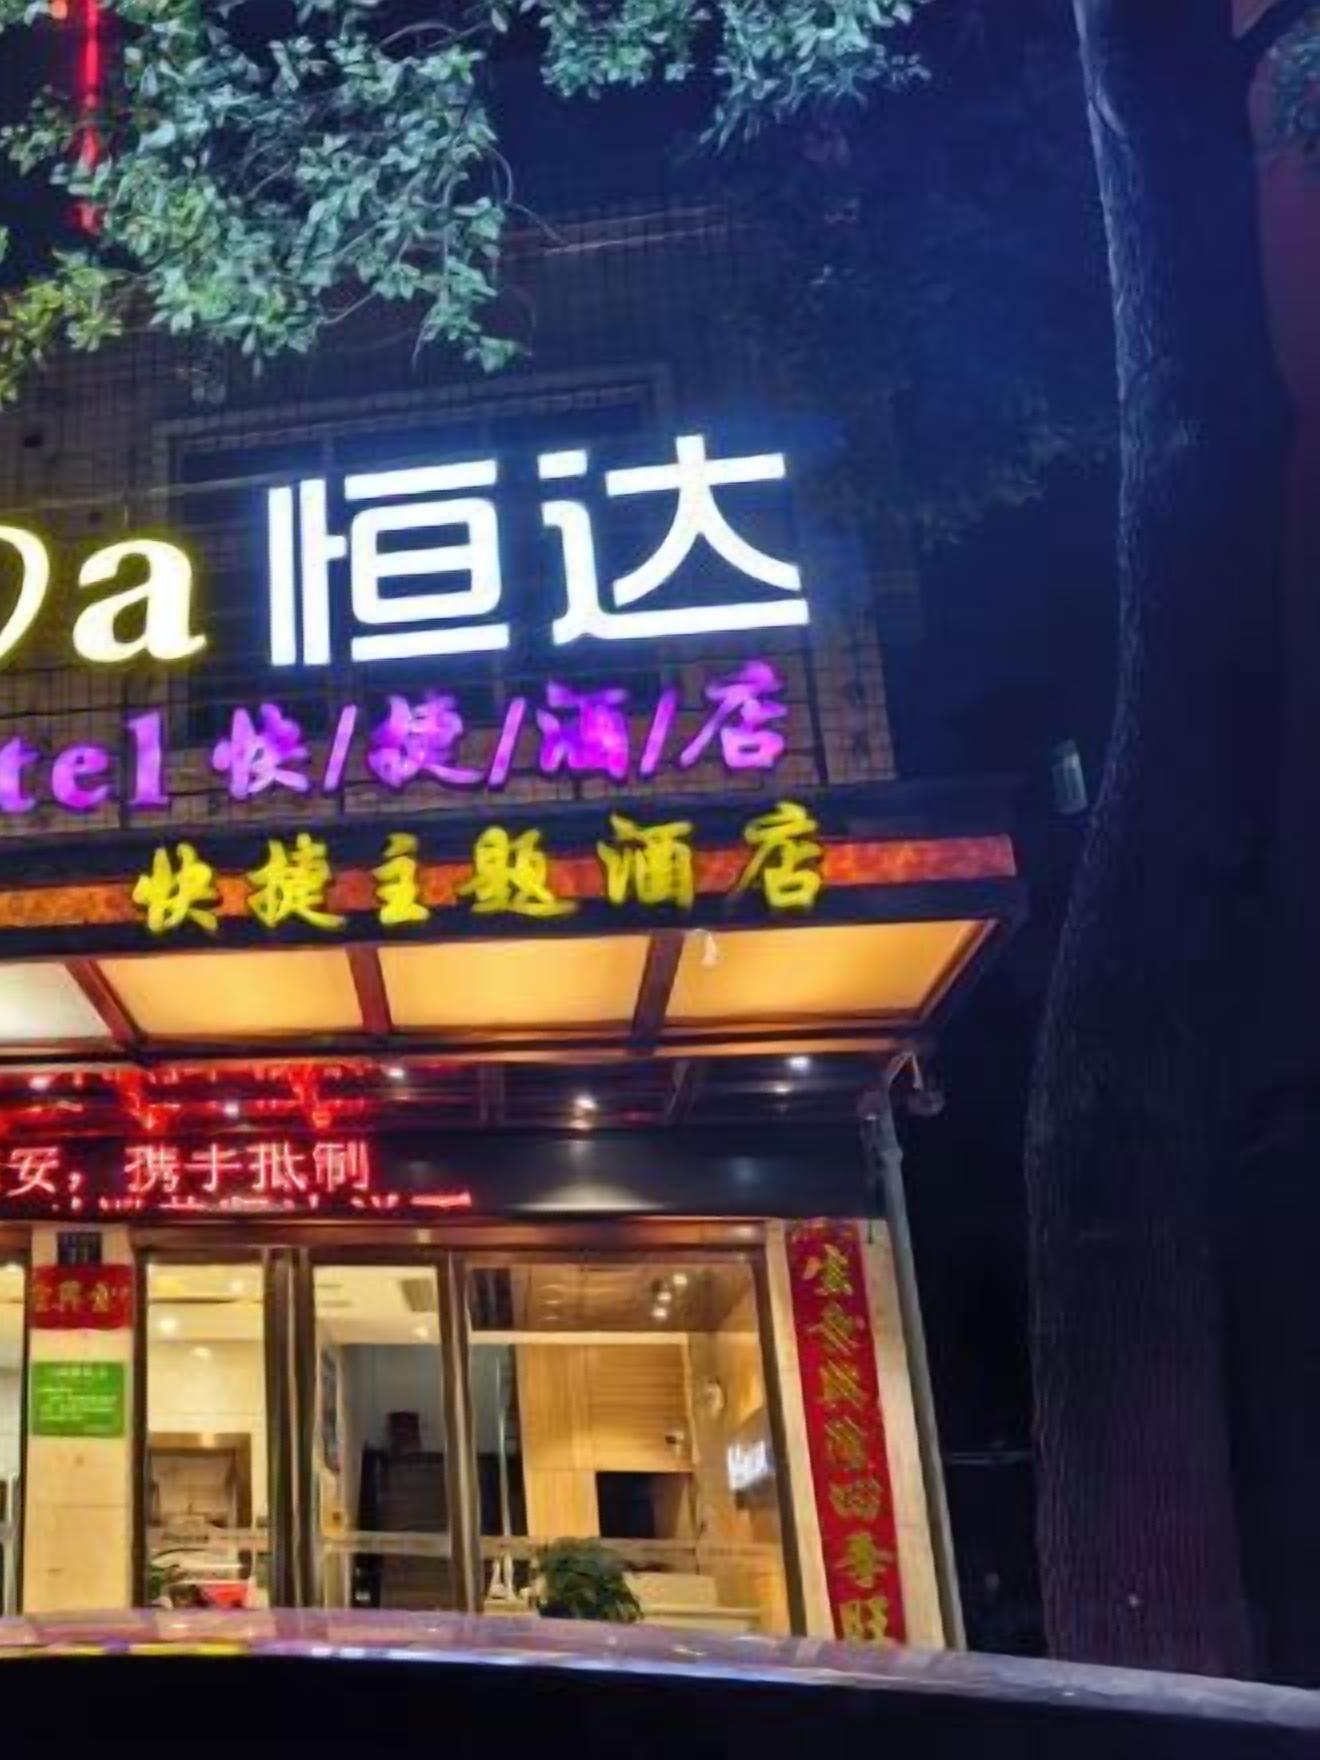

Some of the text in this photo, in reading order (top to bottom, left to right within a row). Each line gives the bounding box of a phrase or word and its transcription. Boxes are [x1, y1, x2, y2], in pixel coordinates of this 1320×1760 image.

[268, 434, 811, 667] 恒达
[132, 801, 823, 932] 快捷主题酒店
